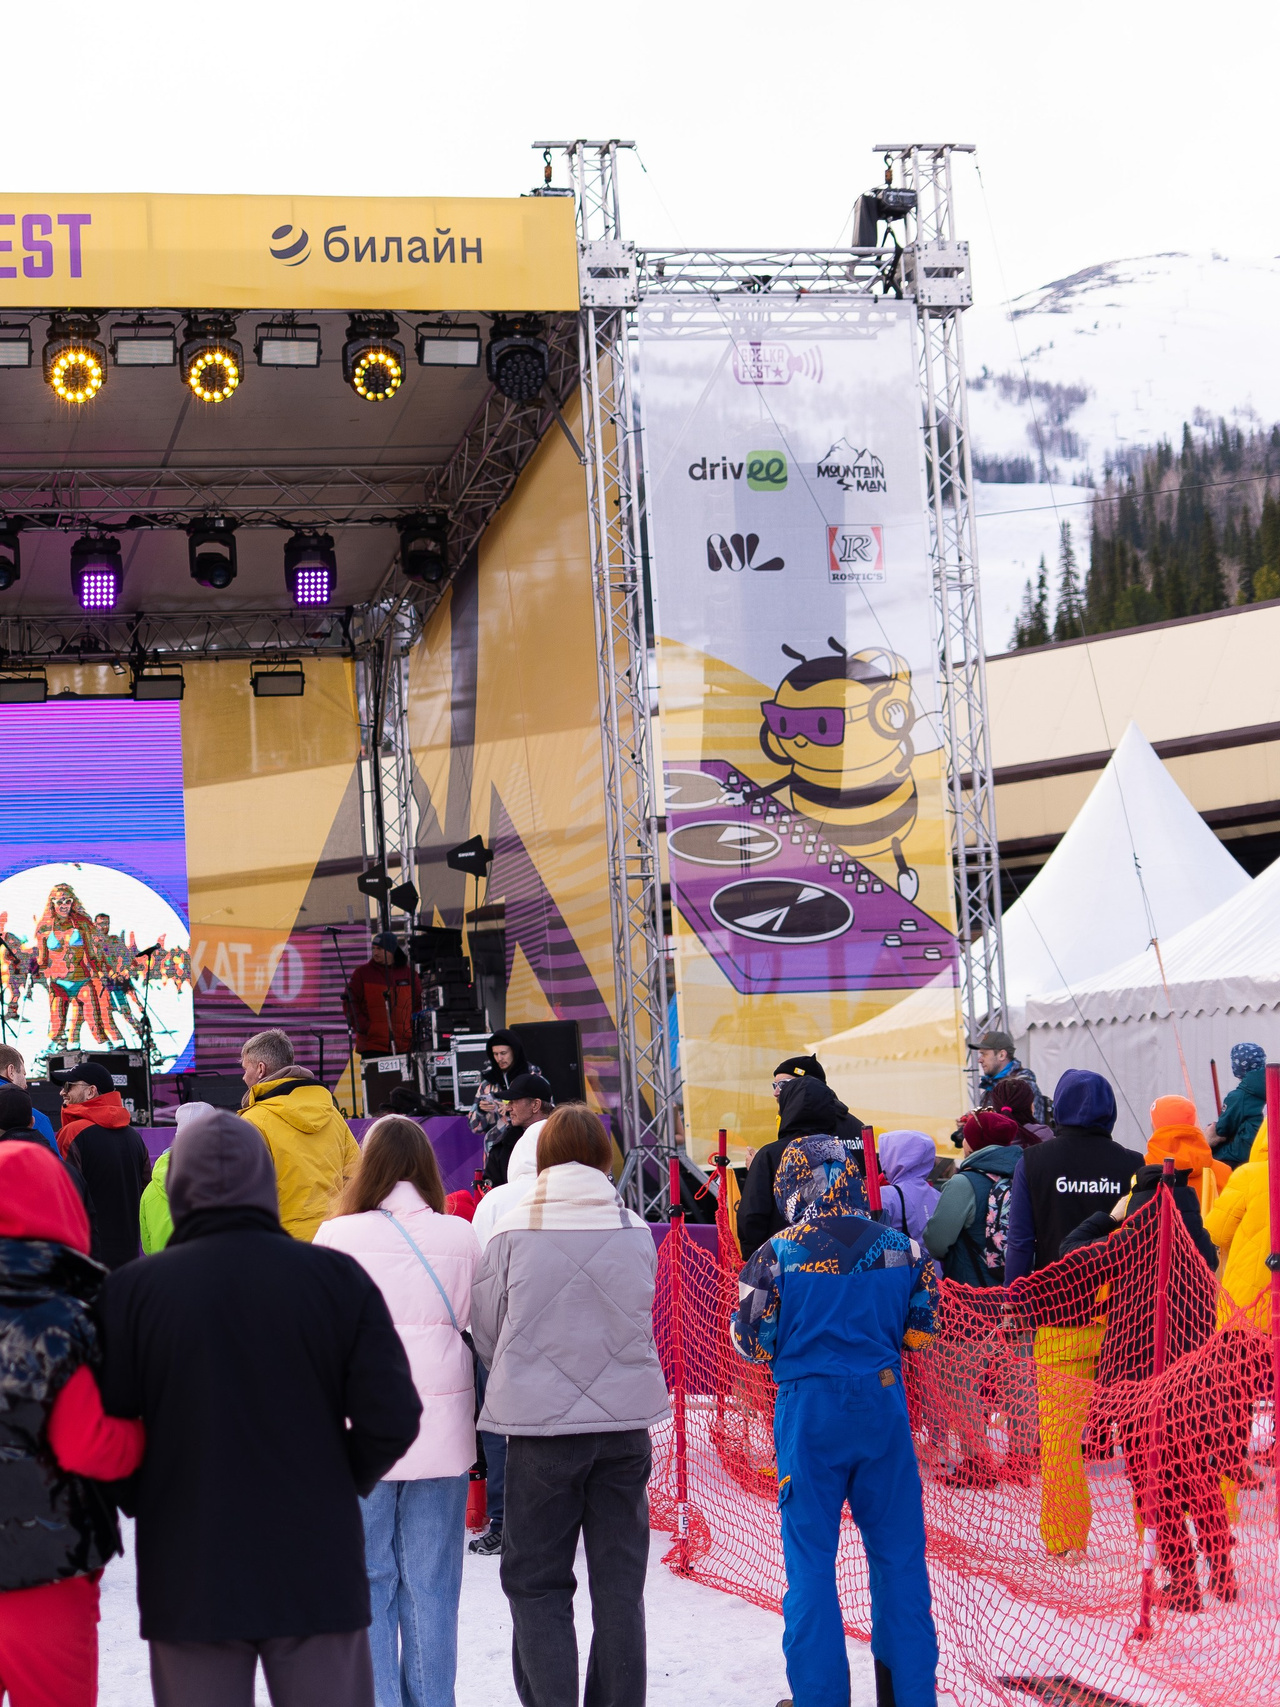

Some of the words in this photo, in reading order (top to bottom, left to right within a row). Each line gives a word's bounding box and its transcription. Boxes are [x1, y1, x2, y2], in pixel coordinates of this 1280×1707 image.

[323, 225, 483, 264] билайн
[740, 347, 785, 363] GRELKA
[742, 364, 771, 379] FEST
[688, 456, 788, 484] drivee
[817, 464, 885, 479] MOUNTAIN
[856, 480, 887, 493] MAN
[831, 572, 884, 581] ROSTIC'S
[379, 1061, 398, 1071] S211
[1055, 1176, 1121, 1194] билайн
